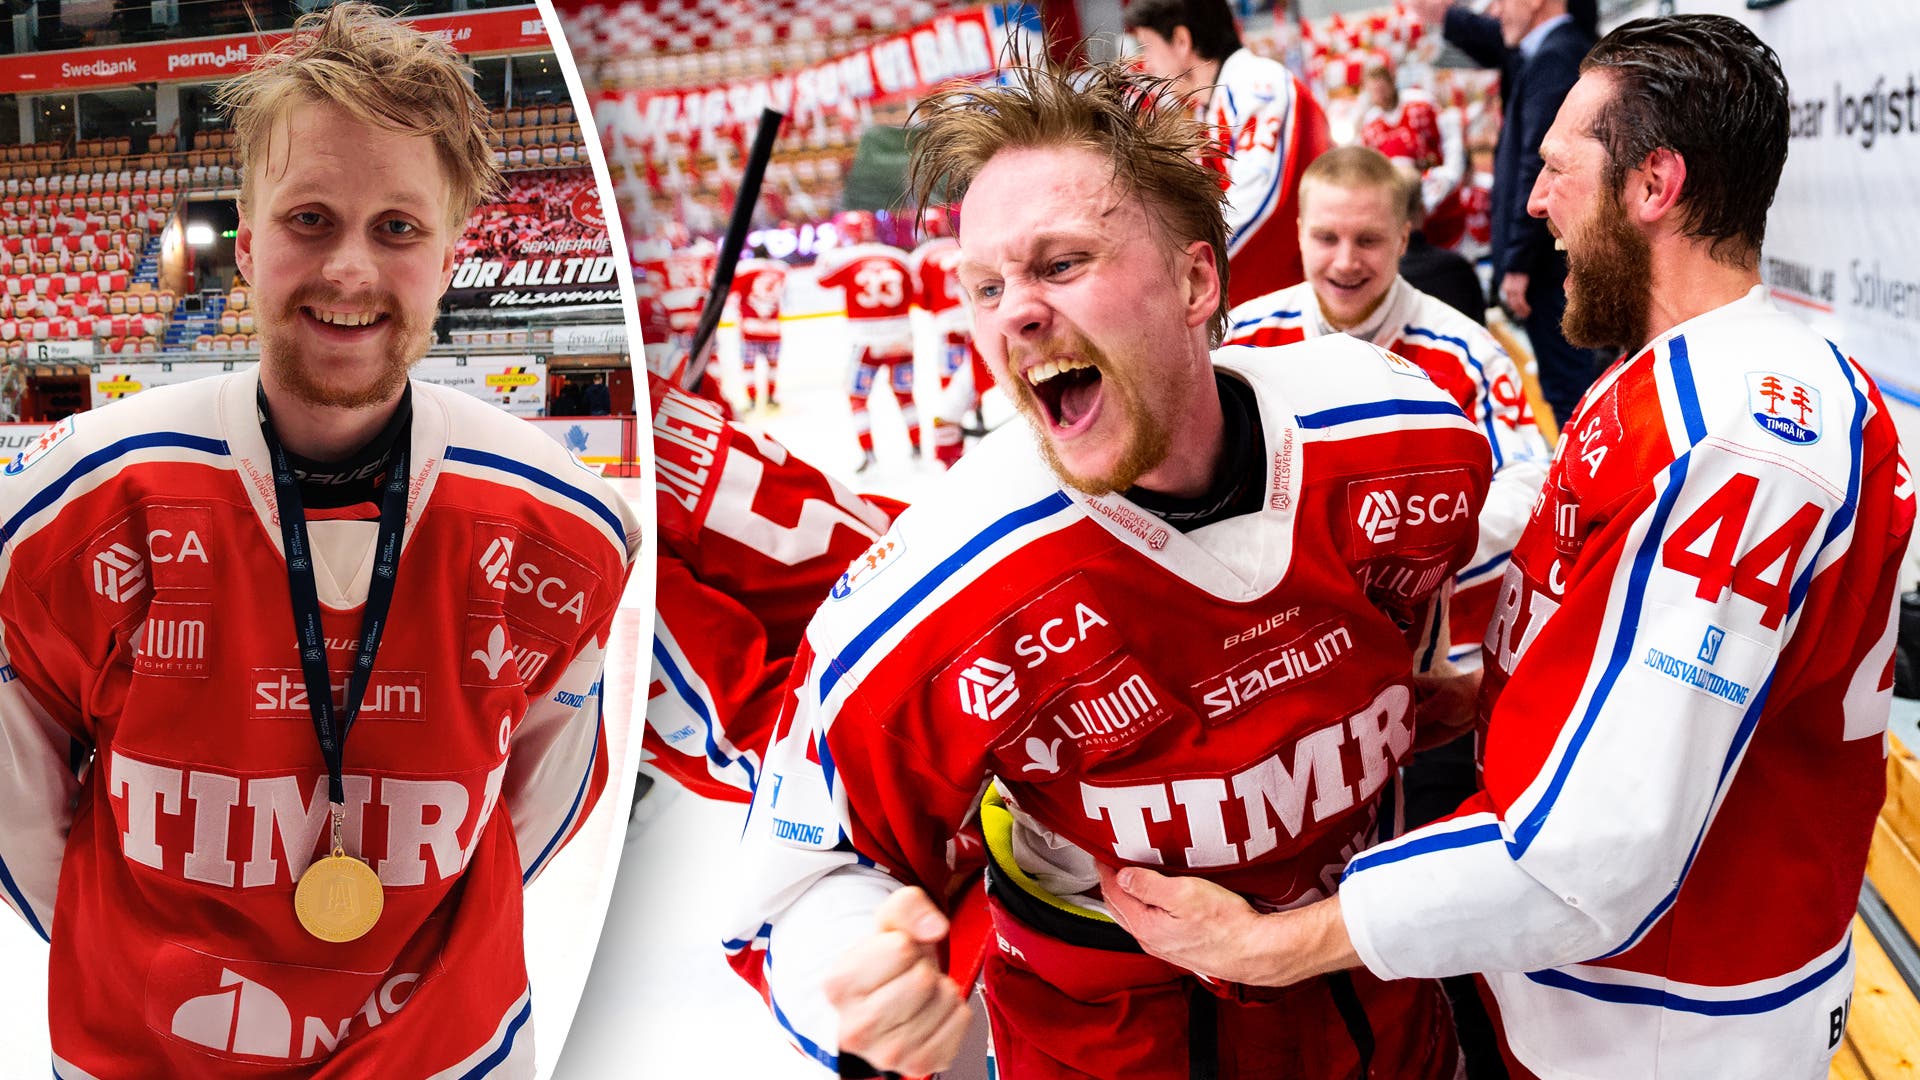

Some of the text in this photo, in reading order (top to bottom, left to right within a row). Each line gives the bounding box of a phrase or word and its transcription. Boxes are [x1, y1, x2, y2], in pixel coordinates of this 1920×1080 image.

[61, 57, 137, 78] Swedbank
[168, 44, 247, 71] permobil
[520, 238, 611, 254] SEPARERADE
[502, 256, 617, 287] ALLTID
[854, 267, 905, 308] 33
[1766, 418, 1806, 441] TIMRÅ IK
[1273, 451, 1283, 490] HOCKEY
[1282, 427, 1293, 491] ALLSVENSKAN
[241, 458, 276, 511] ALLSVENSKAN
[408, 458, 436, 511] ALLSVENSKAN
[1086, 497, 1147, 541] ALLSVENSKAN
[1116, 504, 1154, 531] HOCKEY
[1406, 491, 1469, 526] SCA
[148, 529, 209, 564] CA
[1662, 473, 1824, 631] 44
[509, 562, 585, 624] SCA
[1015, 602, 1109, 669] SCA
[137, 658, 204, 670] IGHETER
[1203, 626, 1353, 719] stadium
[255, 675, 421, 713] stadum
[1053, 674, 1158, 739] LILIUM
[1077, 708, 1164, 748] FASTIGHETER
[1079, 684, 1412, 868] TIMR
